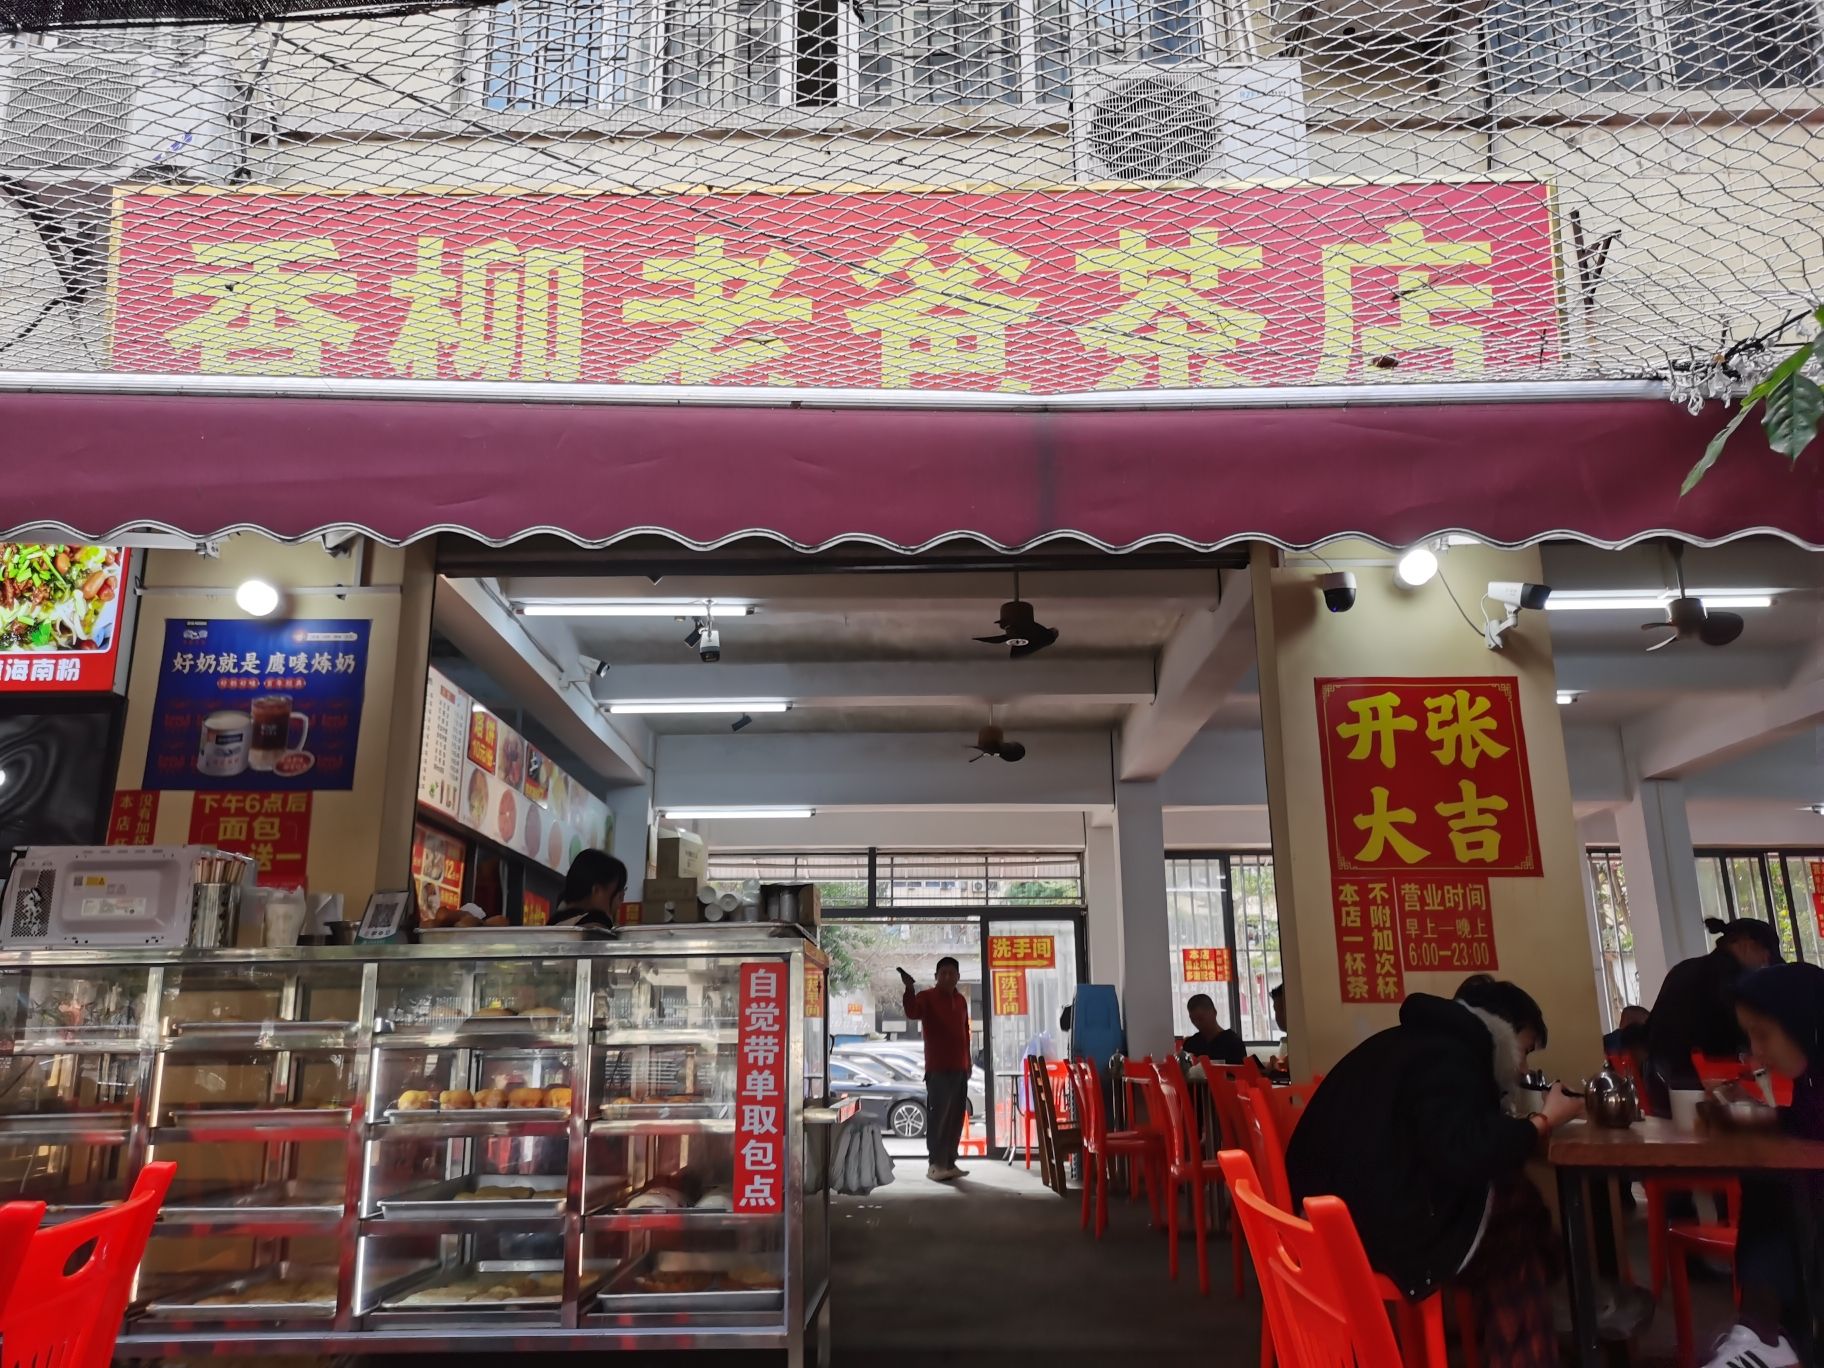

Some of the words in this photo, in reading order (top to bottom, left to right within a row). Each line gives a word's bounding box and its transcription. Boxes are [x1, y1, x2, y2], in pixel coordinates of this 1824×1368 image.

[0, 658, 81, 682] 海南粉
[1335, 689, 1511, 770] 开张
[199, 793, 308, 814] 下午6点后
[218, 816, 280, 841] 面包
[1353, 779, 1509, 865] 大吉
[1400, 882, 1487, 912] 营业时间
[992, 938, 1052, 958] 洗手间
[1189, 949, 1210, 960] 本店
[1338, 883, 1369, 999] 本店一杯茶
[1001, 976, 1019, 1015] 洗手间
[738, 968, 780, 1207] 自觉带单取包点
